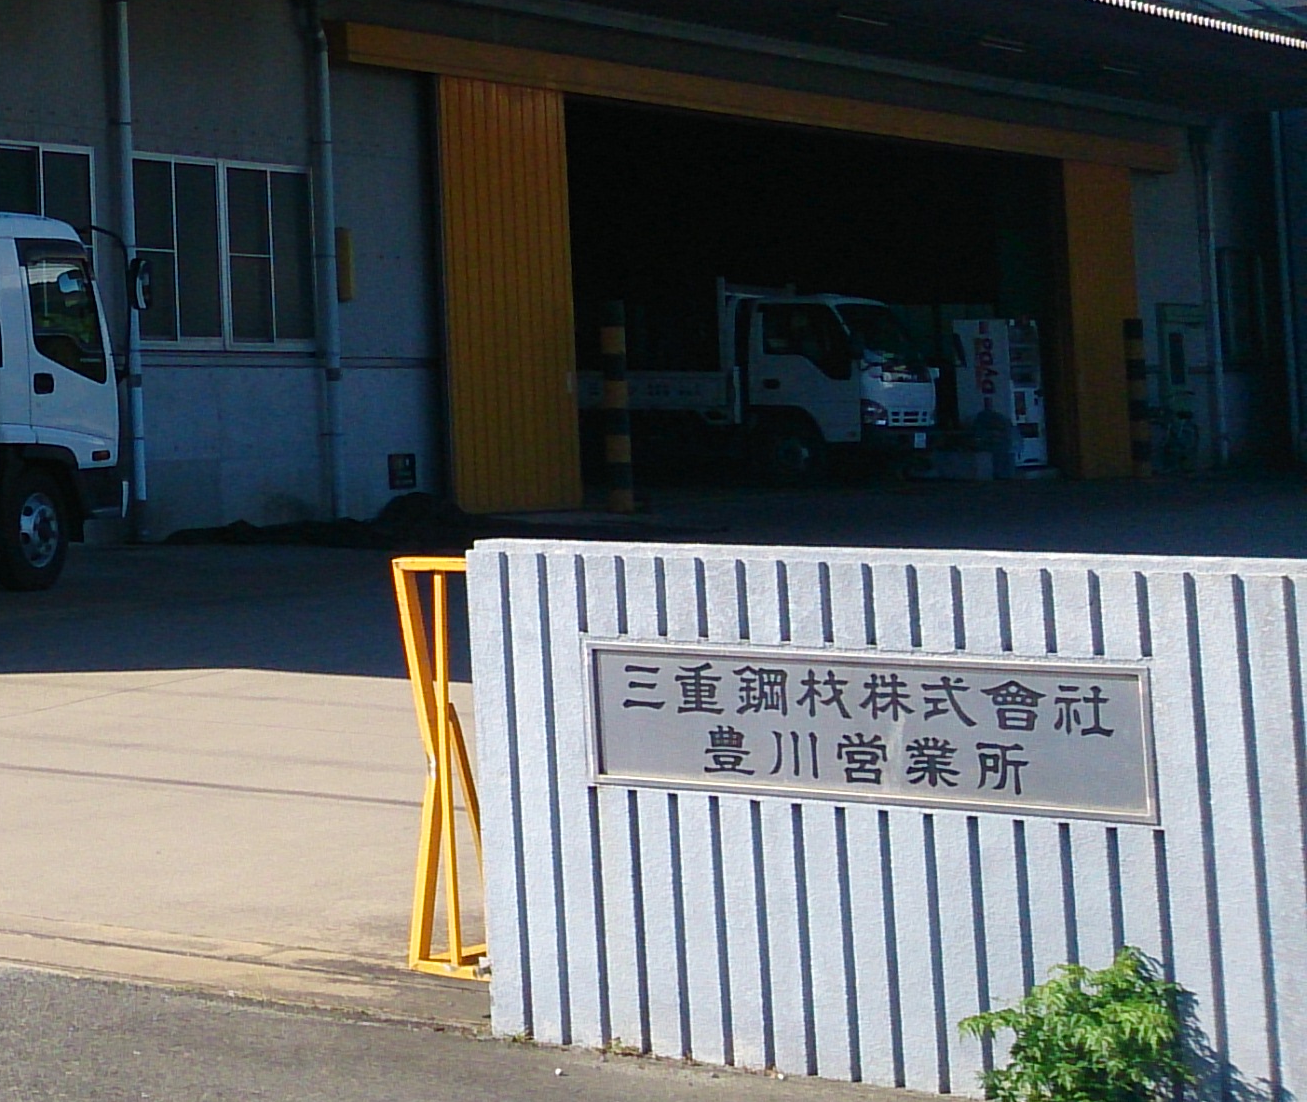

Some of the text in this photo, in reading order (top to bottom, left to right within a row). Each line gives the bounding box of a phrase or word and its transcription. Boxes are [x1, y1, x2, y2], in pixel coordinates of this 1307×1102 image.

[703, 725, 1031, 795] 豊川営業所
